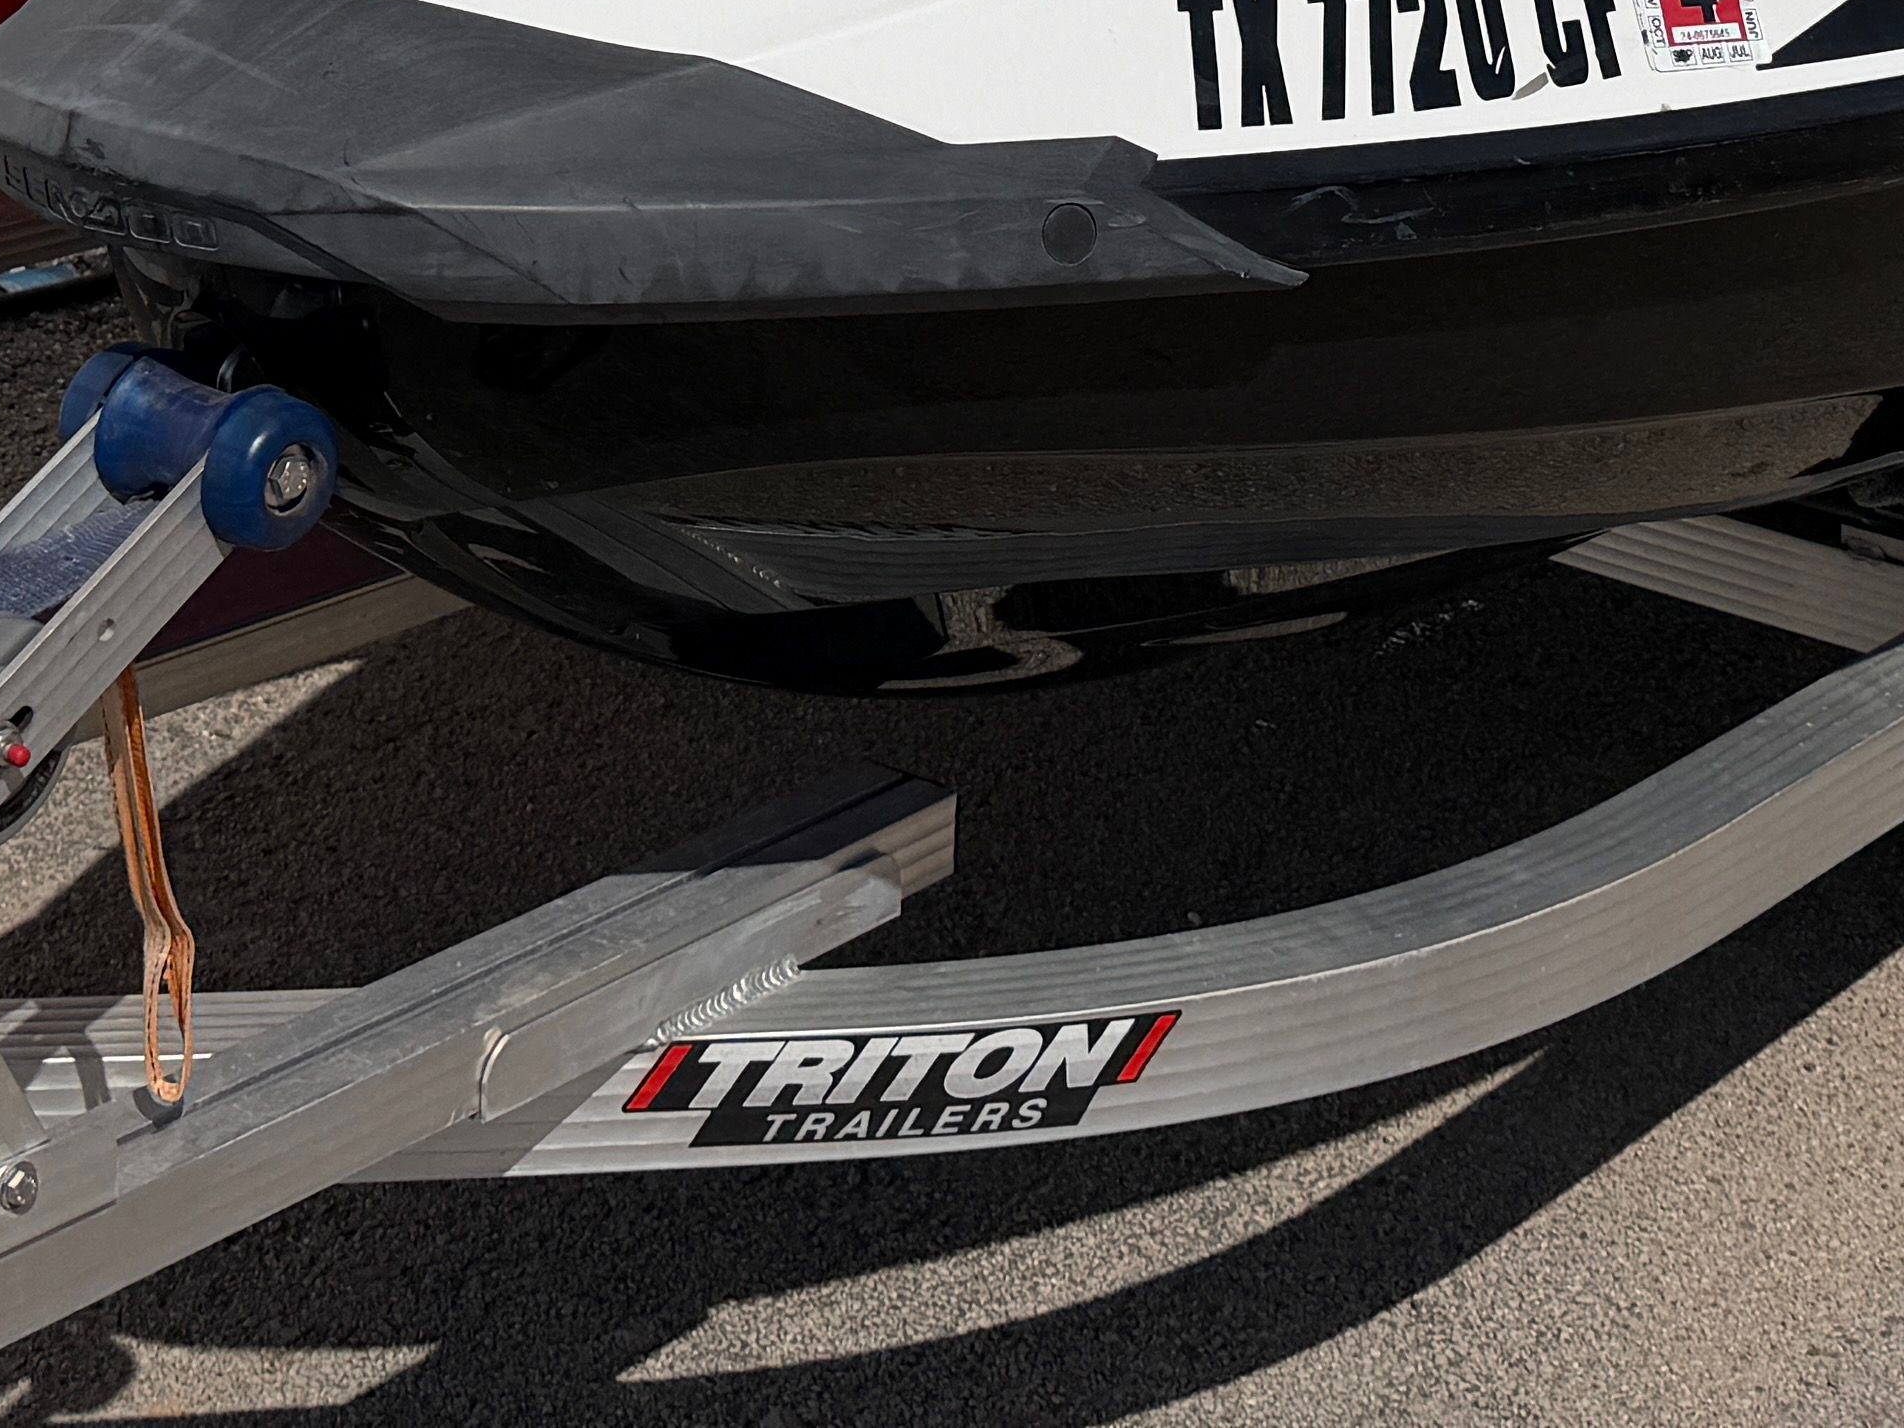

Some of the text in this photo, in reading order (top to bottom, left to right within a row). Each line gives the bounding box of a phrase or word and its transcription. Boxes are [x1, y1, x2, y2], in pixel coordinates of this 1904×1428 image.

[1651, 17, 1665, 45] OCT
[1745, 11, 1758, 38] JUN
[1701, 46, 1722, 61] AUG
[1730, 44, 1750, 58] JUL
[688, 1018, 1135, 1110] TRITON
[761, 1098, 1048, 1143] TRAILERS
